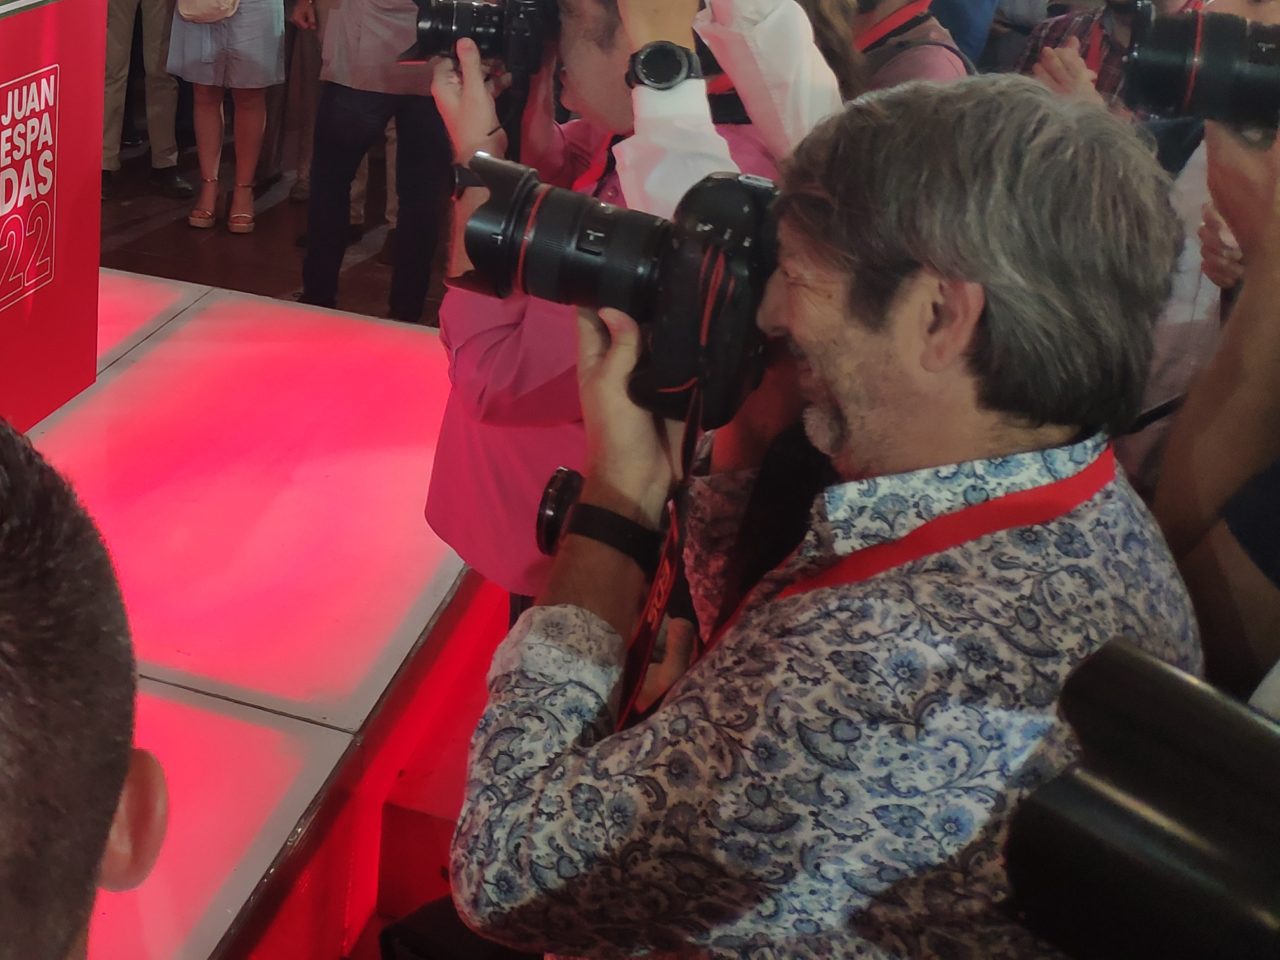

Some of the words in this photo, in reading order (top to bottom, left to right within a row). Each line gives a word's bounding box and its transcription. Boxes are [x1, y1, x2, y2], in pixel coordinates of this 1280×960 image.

[0, 74, 55, 126] JUAN
[0, 112, 53, 168] ESPA
[0, 149, 53, 217] DAS
